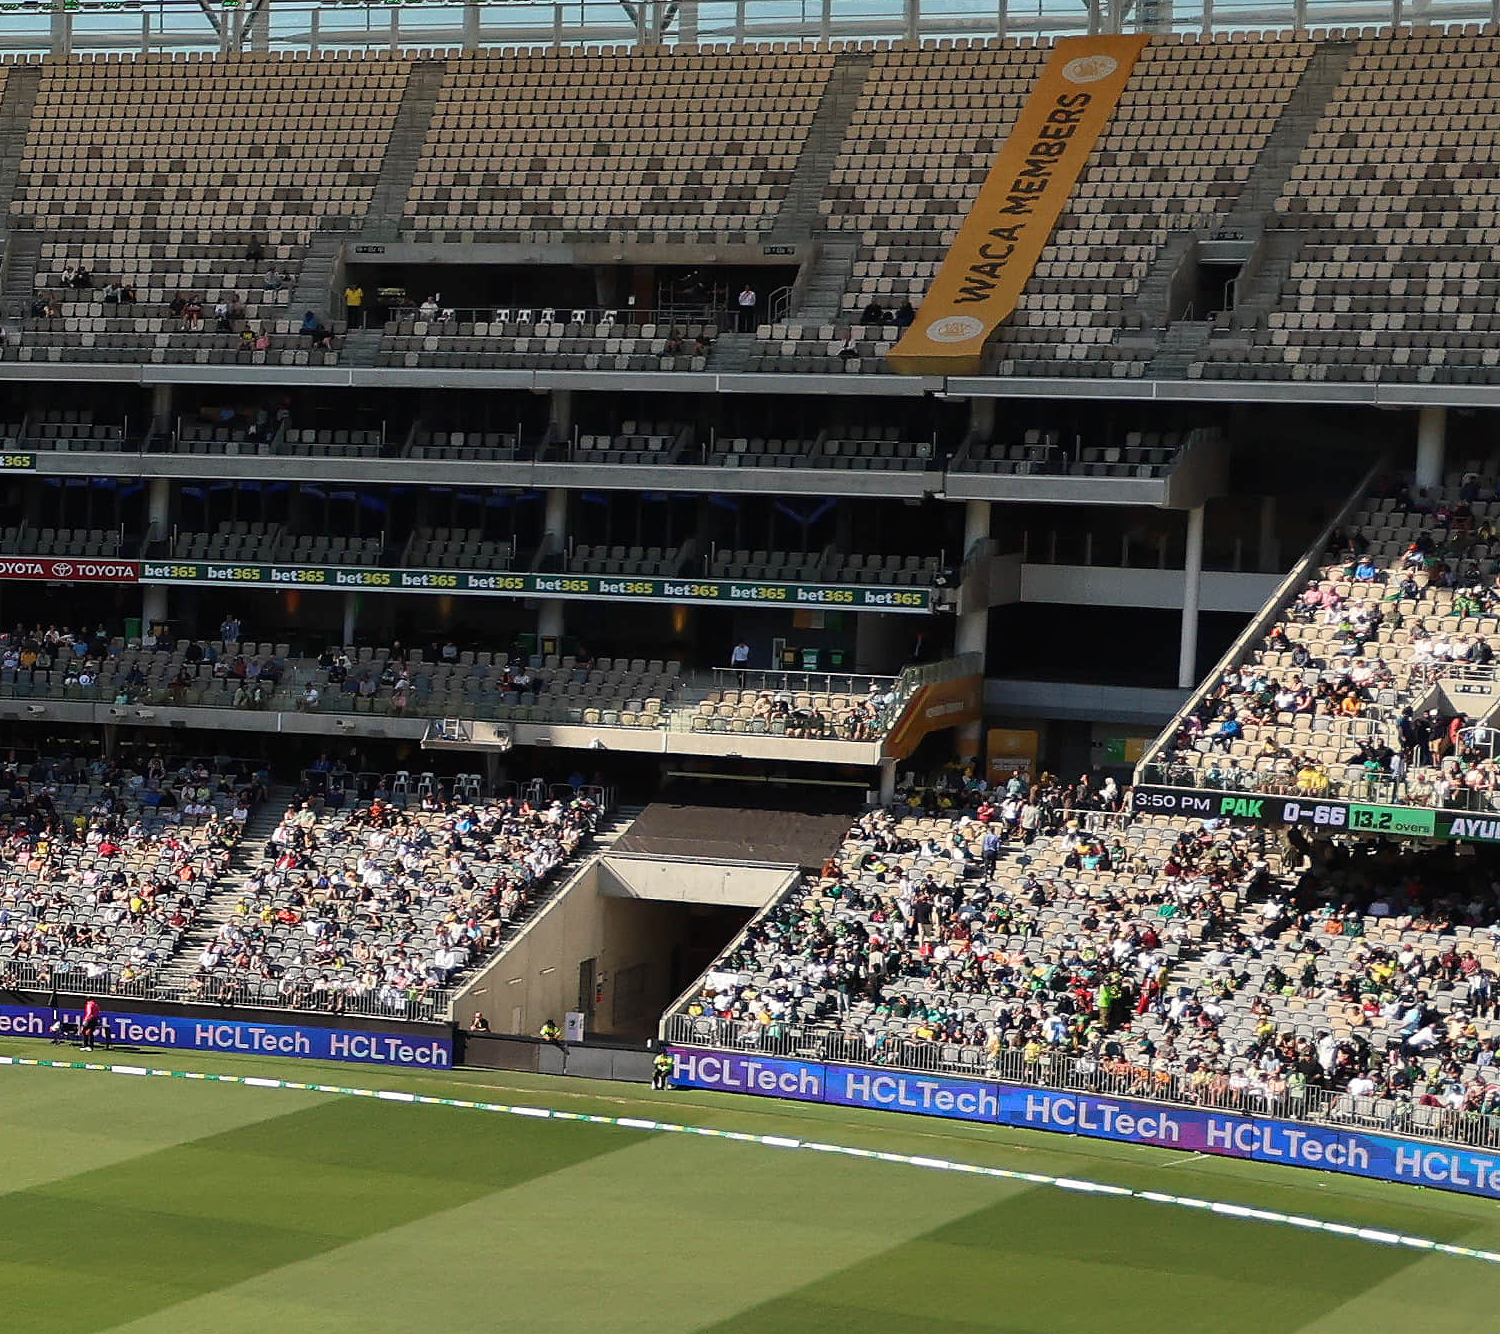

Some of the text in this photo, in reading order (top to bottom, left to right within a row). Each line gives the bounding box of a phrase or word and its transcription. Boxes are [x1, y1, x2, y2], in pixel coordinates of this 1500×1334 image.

[953, 92, 1092, 304] WACA MEMBERS
[77, 565, 133, 576] TOYOTA
[145, 566, 197, 577] bet365
[208, 567, 260, 580] bet365
[337, 572, 390, 584] bet365
[402, 574, 458, 587] bet365
[536, 578, 588, 591] bet365
[600, 581, 653, 594] bet365
[731, 586, 786, 599] bet365
[798, 589, 853, 602] bet365
[865, 592, 921, 605] bet365
[1135, 793, 1211, 812] 3:50 PM
[1220, 797, 1347, 826] PAK 0-66
[1353, 810, 1431, 834] 13.2 overs
[195, 1024, 310, 1054] HCLTech
[331, 1035, 447, 1065] HCLTech
[673, 1052, 819, 1095] HCLTech
[847, 1073, 999, 1117] HCLTech
[1026, 1095, 1178, 1142] HCLTech
[1207, 1118, 1368, 1168] HCLTech
